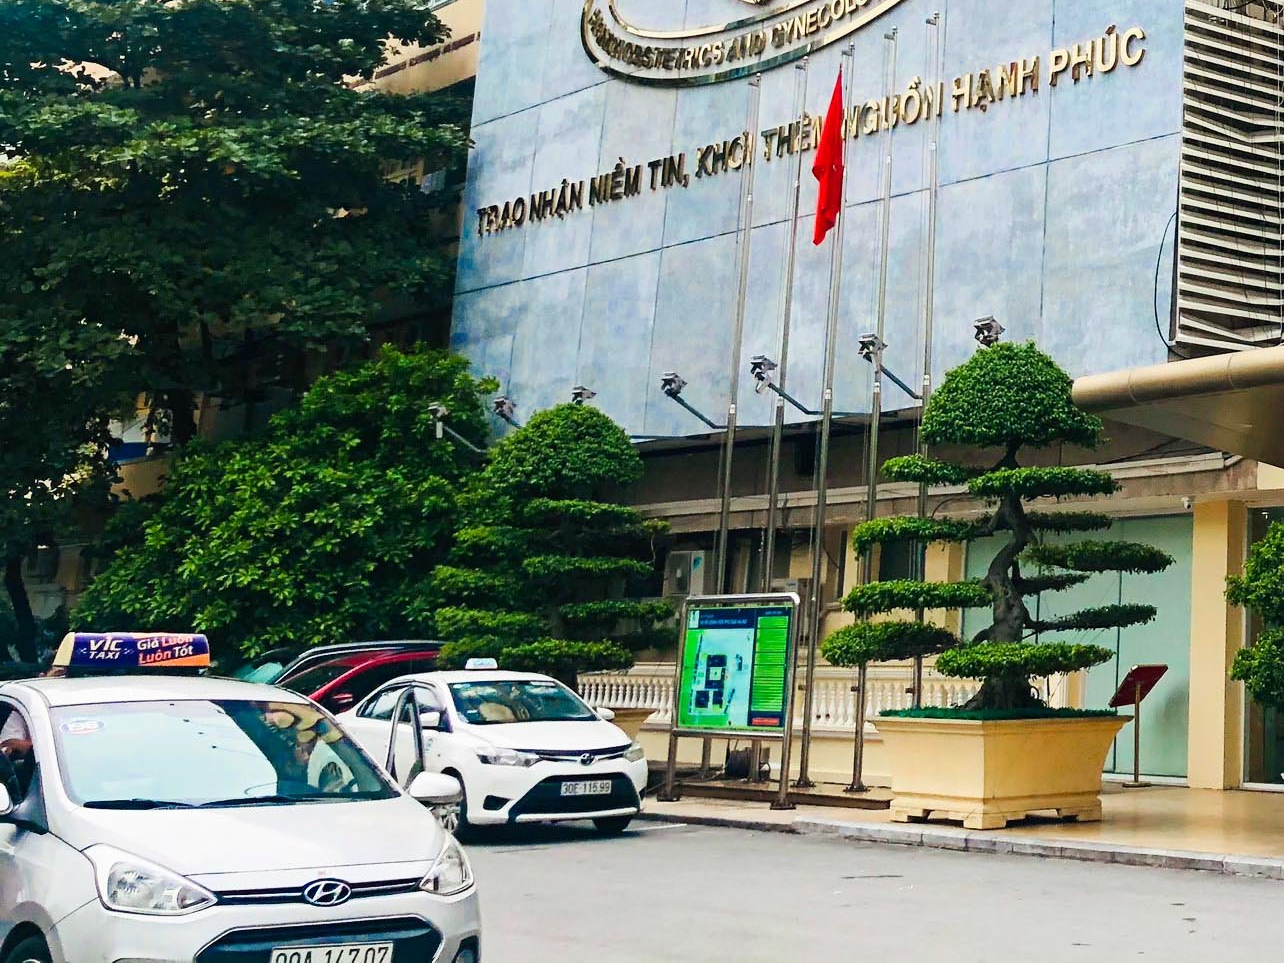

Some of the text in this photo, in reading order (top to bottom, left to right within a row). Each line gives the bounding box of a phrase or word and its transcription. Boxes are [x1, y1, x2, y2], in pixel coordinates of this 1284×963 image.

[725, 30, 767, 63] AND
[476, 196, 527, 237] TRAO
[528, 178, 585, 221] NHẬN
[588, 156, 643, 207] NIỀM
[647, 151, 691, 190] TIN,
[951, 54, 1041, 113] HẠNH
[1048, 24, 1147, 87] PHÚC
[88, 644, 194, 664] TAXI Luôn Tốt
[136, 637, 160, 651] Giá
